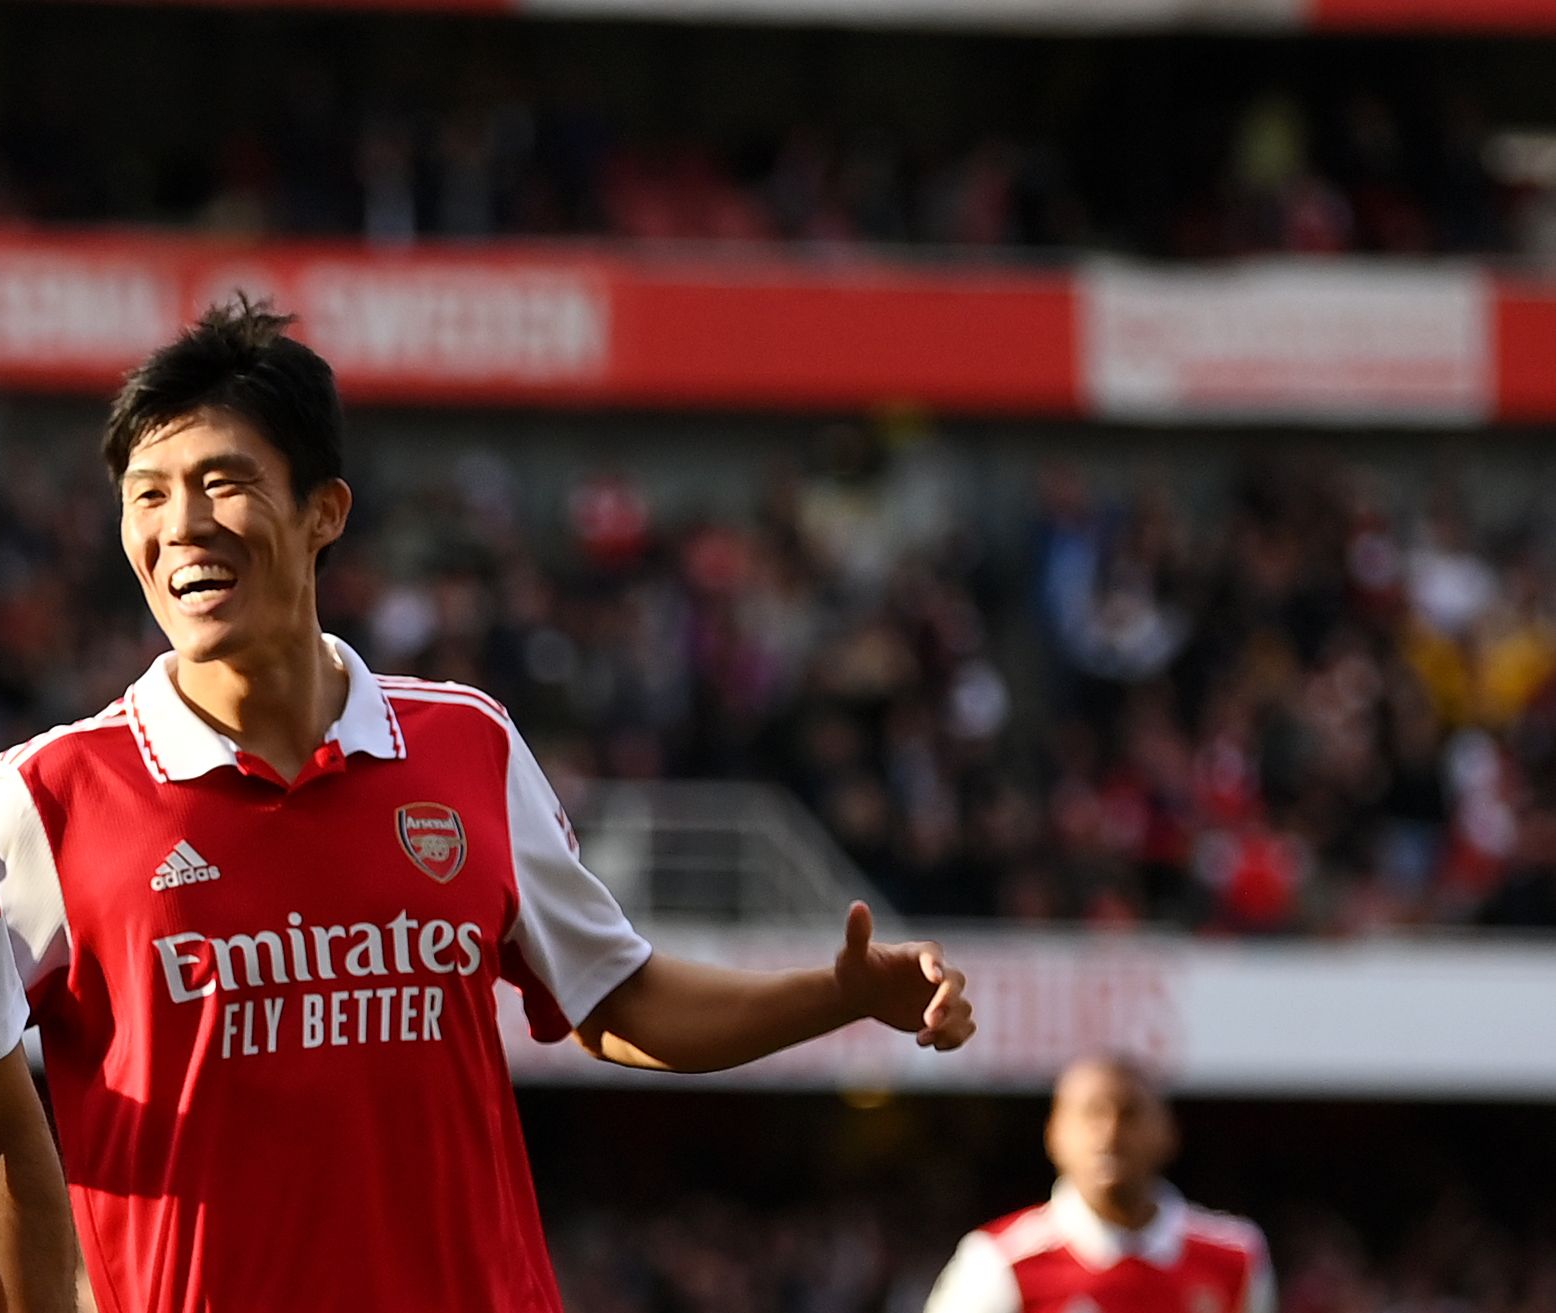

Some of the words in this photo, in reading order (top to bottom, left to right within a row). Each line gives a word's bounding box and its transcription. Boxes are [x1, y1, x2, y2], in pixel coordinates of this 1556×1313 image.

[151, 864, 221, 892] adidas
[152, 908, 482, 1004] Emirates
[221, 997, 284, 1060] FLY
[302, 986, 444, 1050] BETTER
